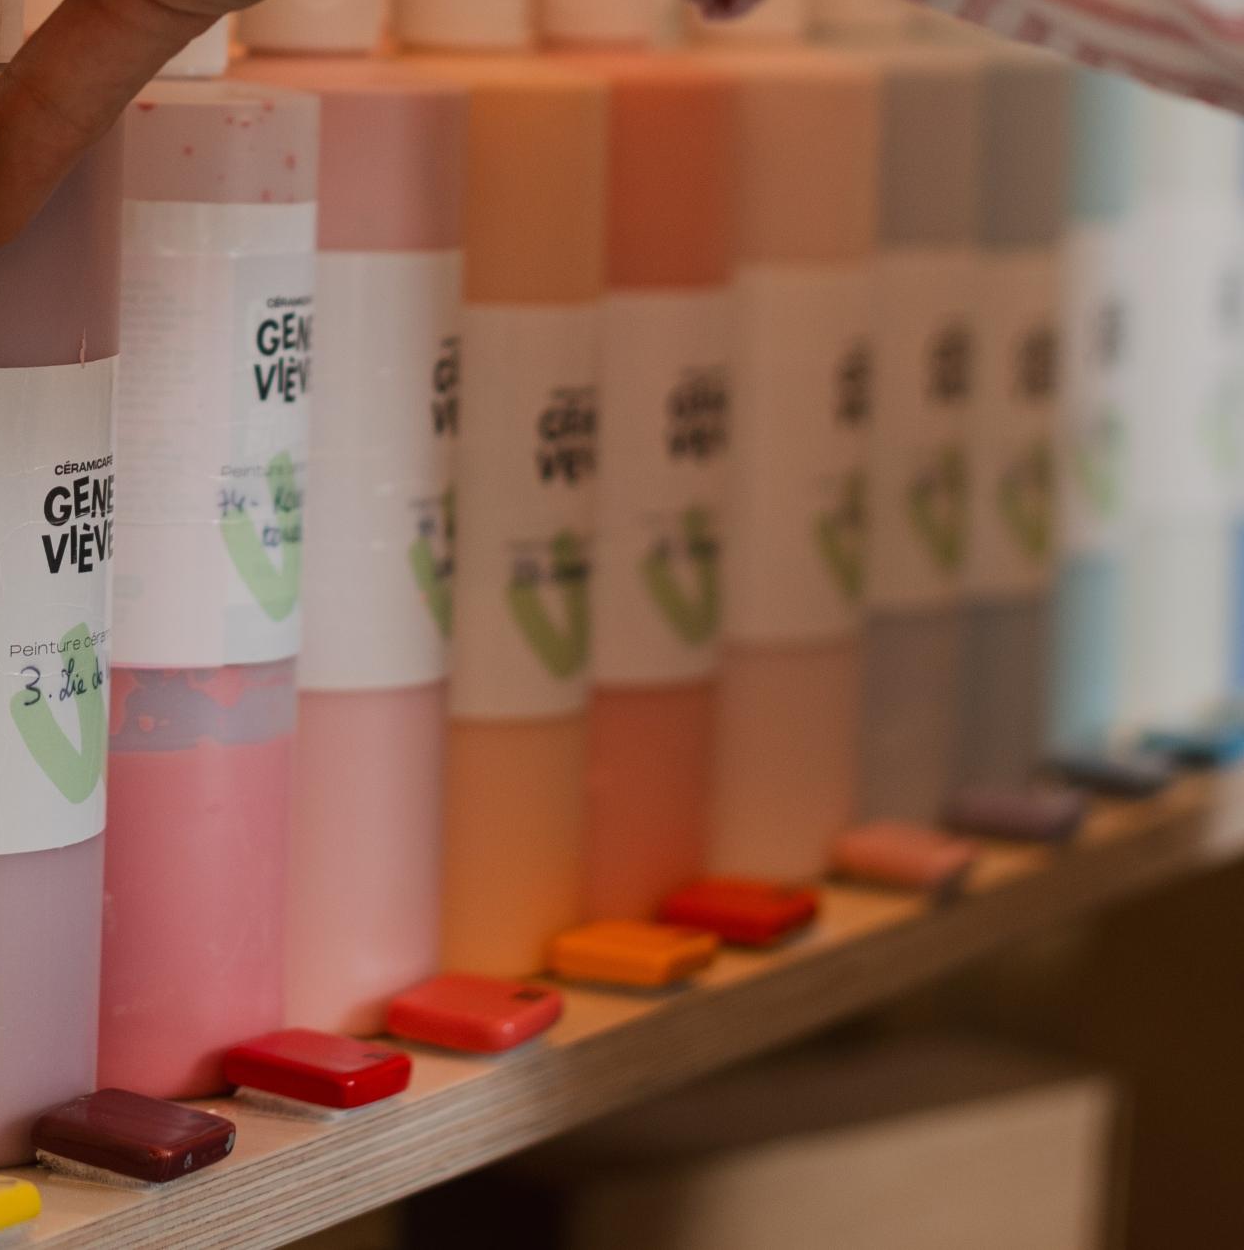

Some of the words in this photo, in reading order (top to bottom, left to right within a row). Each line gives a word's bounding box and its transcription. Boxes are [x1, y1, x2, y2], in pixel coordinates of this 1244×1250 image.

[256, 312, 314, 356] GEN
[253, 355, 313, 403] VIÈV
[43, 473, 115, 527] GENE
[41, 519, 114, 575] VIÈVE
[9, 637, 81, 657] Peinture
